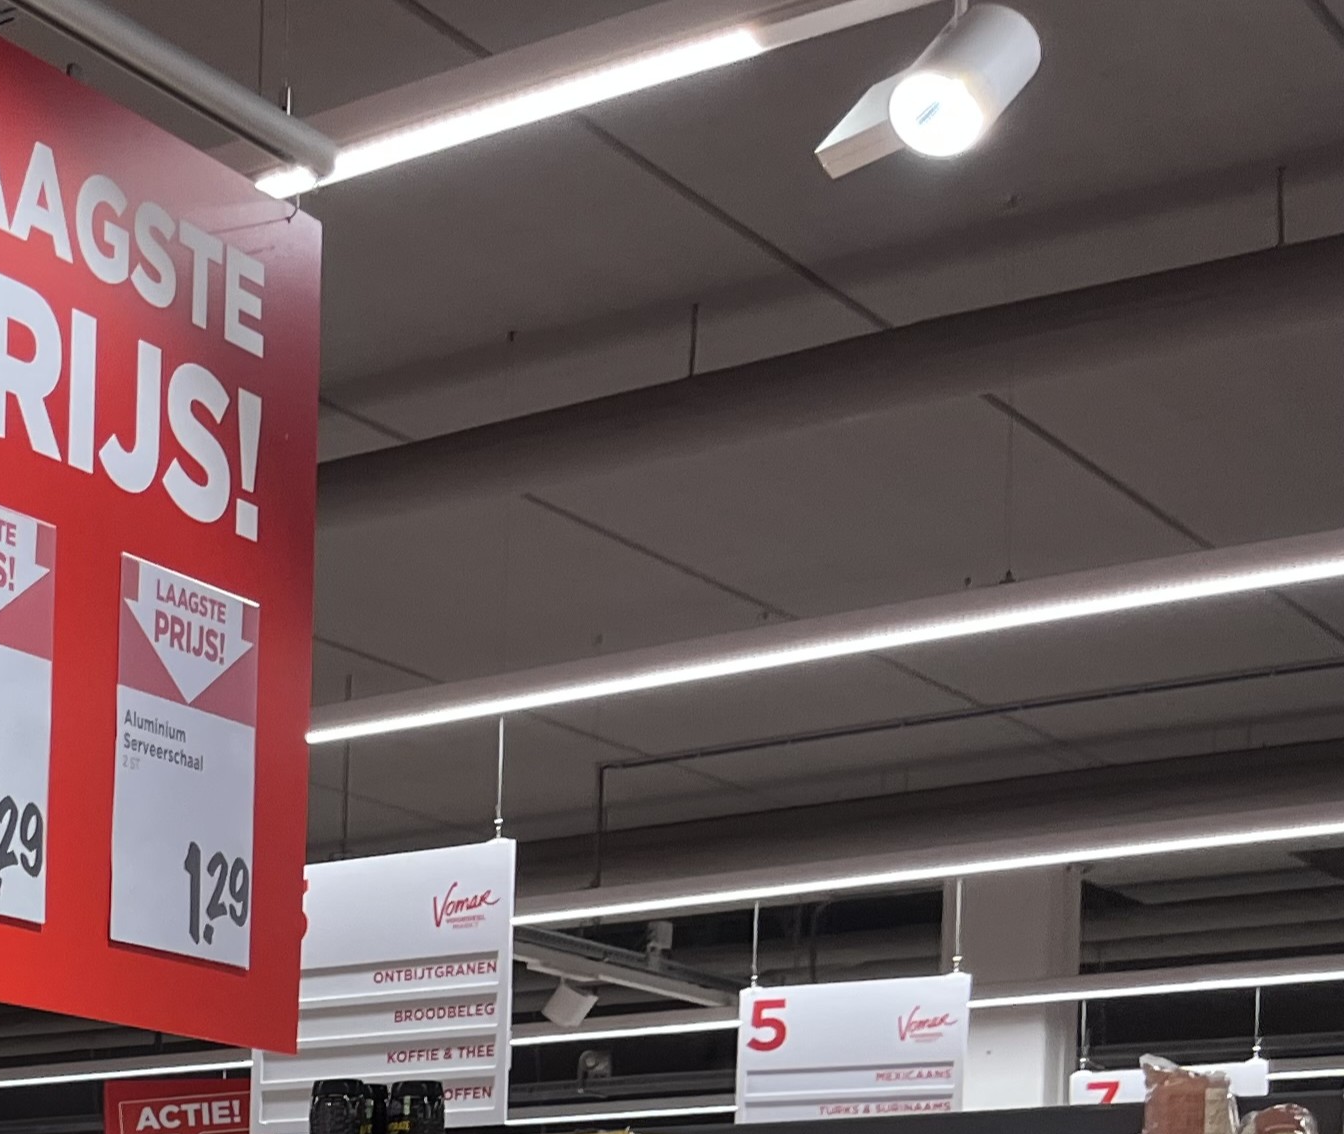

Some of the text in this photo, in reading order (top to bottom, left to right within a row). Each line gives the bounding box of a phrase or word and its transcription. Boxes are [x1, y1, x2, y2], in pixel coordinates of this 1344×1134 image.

[156, 578, 227, 624] LAAGSTE
[154, 610, 226, 666] PRIJS!
[123, 709, 187, 744] Aluminium
[123, 733, 204, 773] Serveerschaal
[183, 840, 250, 946] 1.29
[433, 881, 501, 929] Vomar
[373, 960, 498, 985] ONTBIJTGRANEN
[394, 1002, 496, 1024] BROODBELEG
[746, 997, 788, 1052] 5
[386, 1043, 495, 1064] KOFFIE & THEE
[875, 1067, 953, 1082] MEXICAANS
[1086, 1080, 1121, 1104] 7
[136, 1100, 242, 1132] ACTIE!
